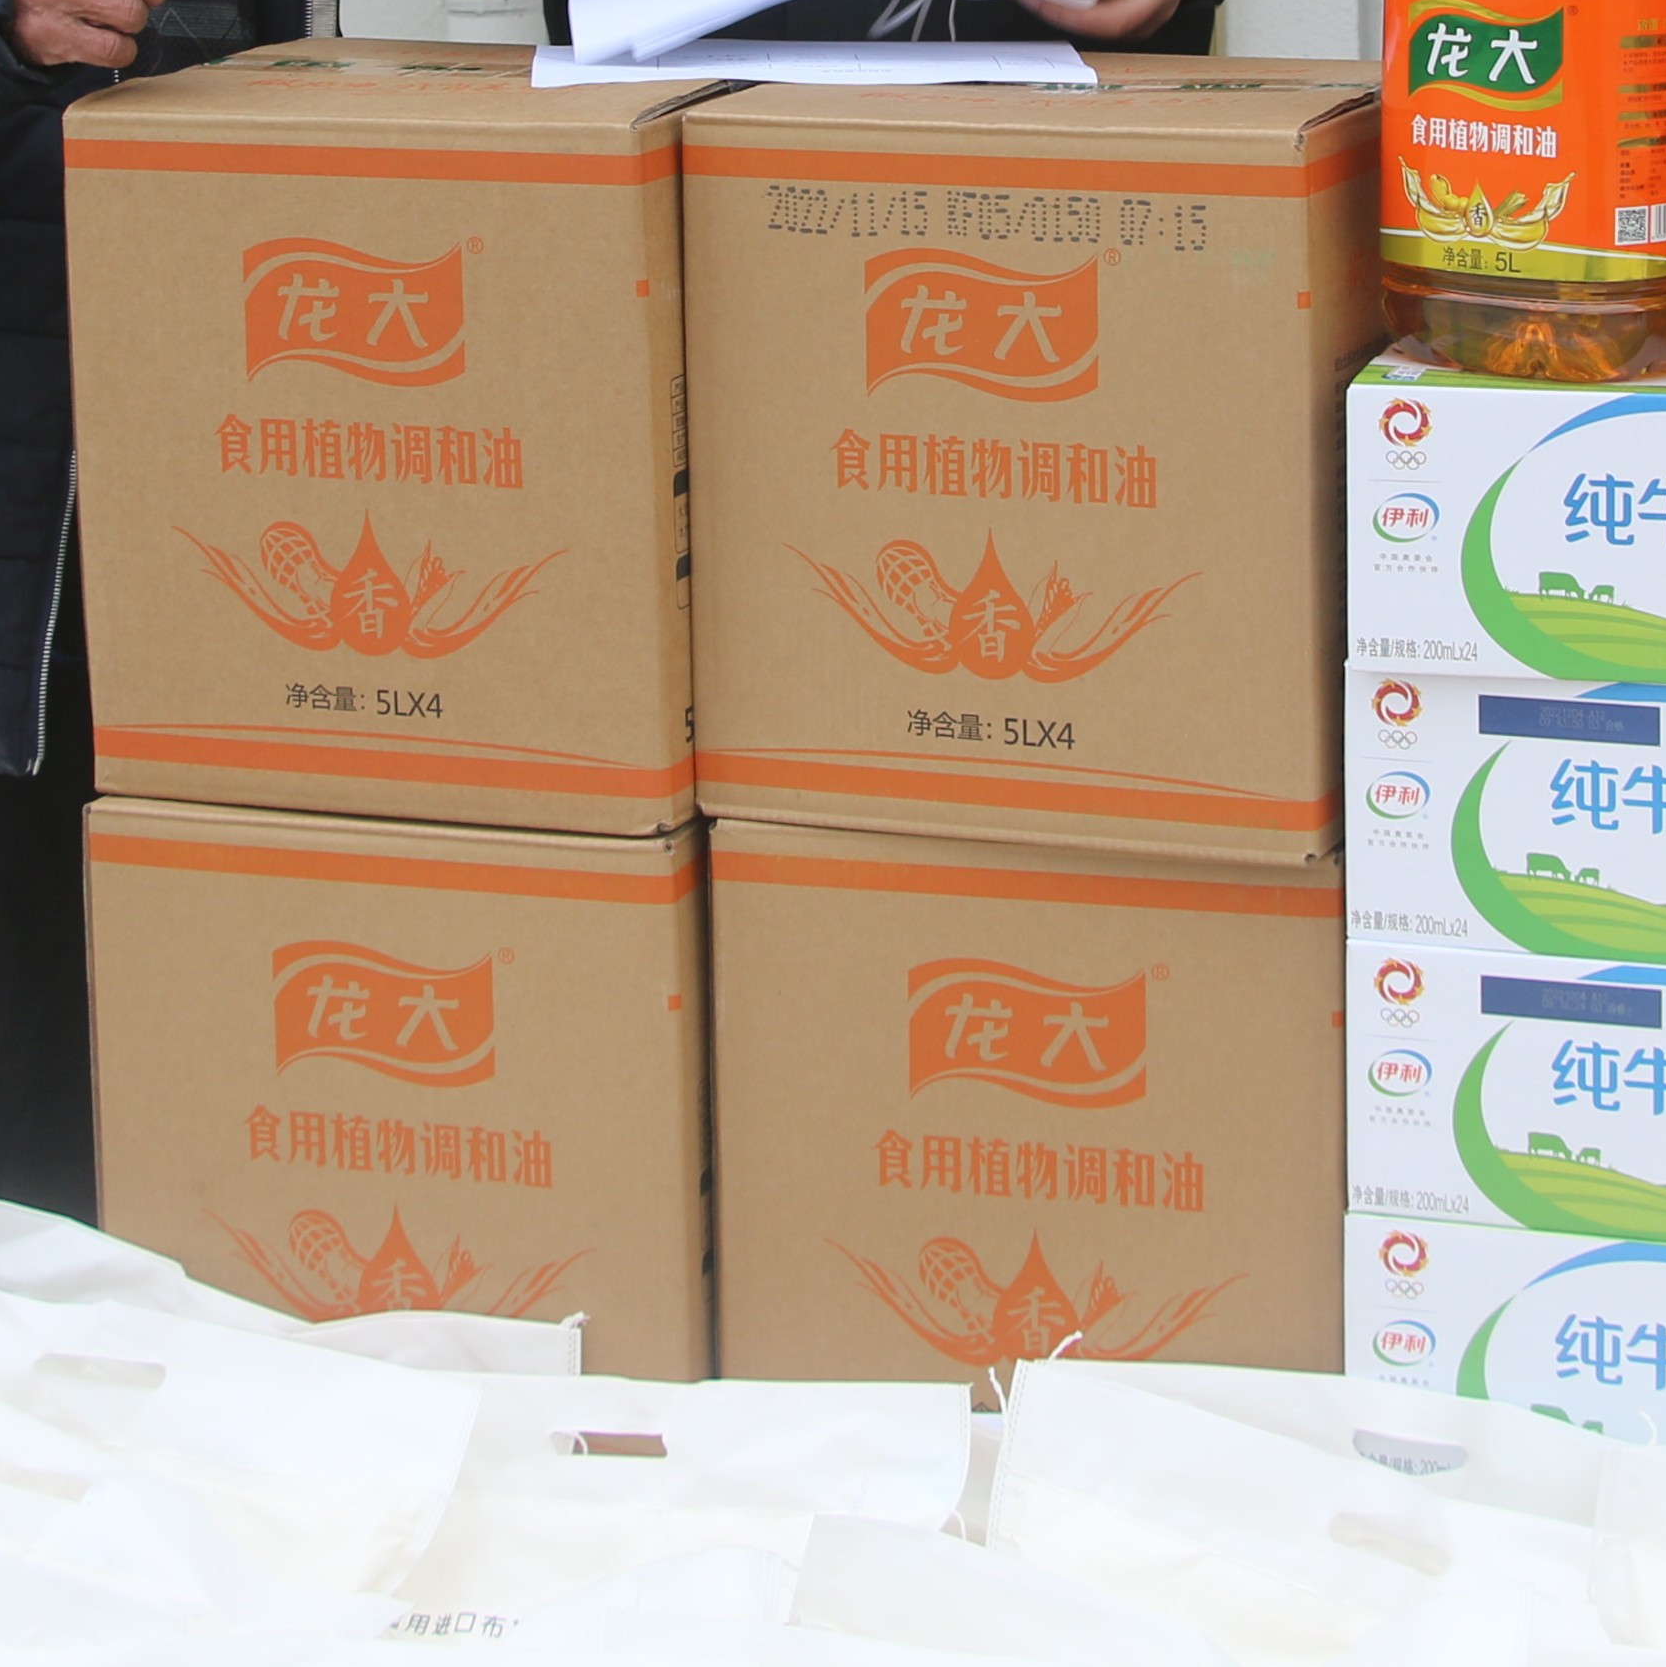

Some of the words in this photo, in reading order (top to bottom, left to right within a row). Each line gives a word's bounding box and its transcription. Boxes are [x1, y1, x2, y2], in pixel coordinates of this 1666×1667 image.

[1427, 23, 1538, 85] 龙大
[1411, 113, 1557, 159] 食用植物调和油
[277, 274, 429, 349] 龙大
[900, 286, 1062, 363] 龙大
[214, 413, 524, 489] 食用植物调和油
[831, 428, 1157, 509] 食用植物调和油
[1381, 506, 1430, 530] 伊利
[343, 568, 400, 638] 香
[962, 589, 1021, 663] 香
[1374, 783, 1421, 807] 伊利
[307, 975, 459, 1051] 龙大
[944, 993, 1110, 1071] 龙大
[1376, 1062, 1422, 1085] 伊利
[245, 1104, 553, 1189] 食用植物调和油
[872, 1129, 1204, 1213] 食用植物调和油
[1008, 1285, 1066, 1353] 香
[1381, 1331, 1426, 1355] 伊利
